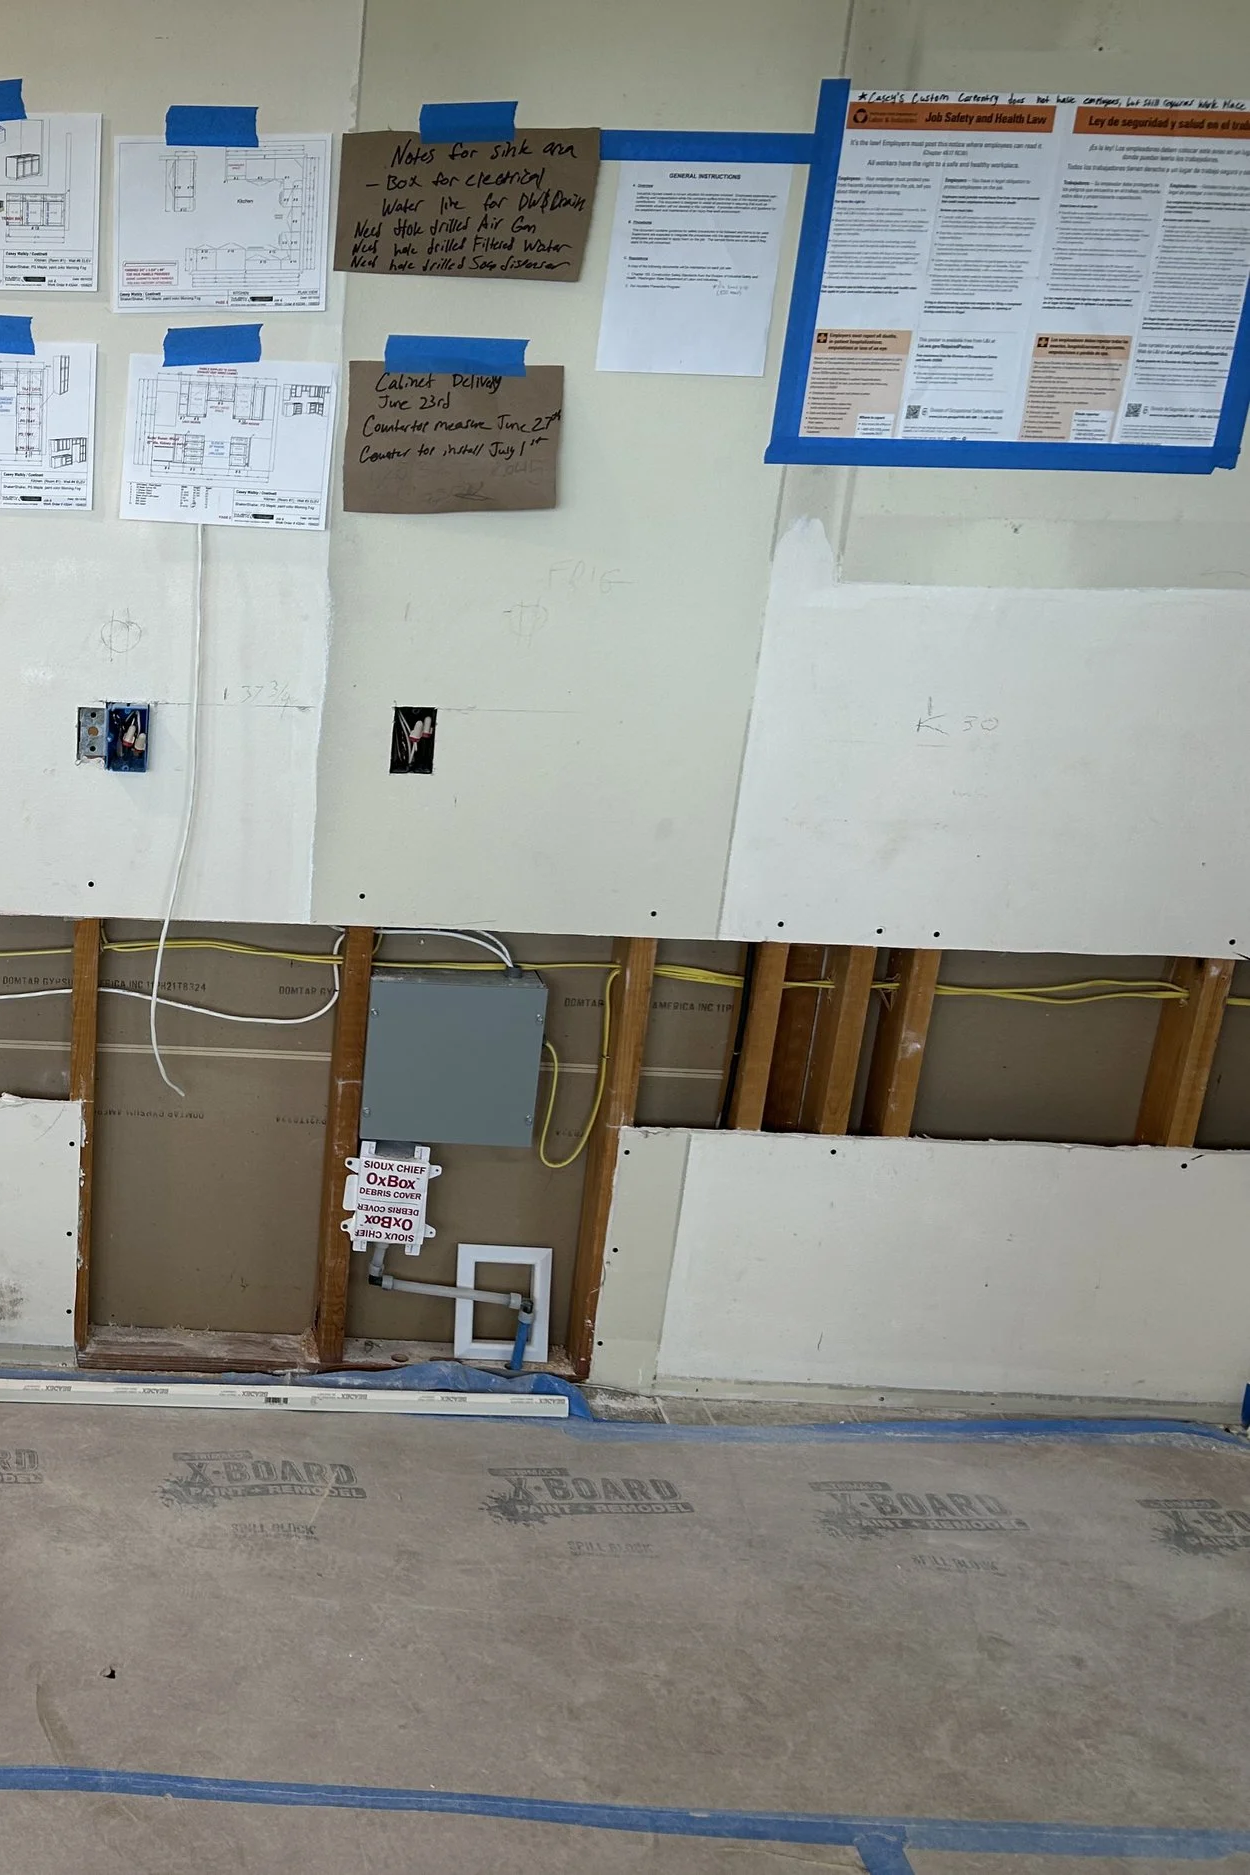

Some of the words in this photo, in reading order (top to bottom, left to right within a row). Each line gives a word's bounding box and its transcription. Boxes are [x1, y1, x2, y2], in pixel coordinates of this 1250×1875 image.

[912, 92, 949, 103] Custom
[925, 112, 943, 123] Job
[944, 112, 975, 126] Safety
[976, 113, 993, 124] and
[994, 112, 1024, 125] Health
[1026, 114, 1046, 125] Law
[1088, 115, 1105, 129] Ley
[1107, 116, 1119, 127] de
[1121, 116, 1168, 130] seguridad
[1170, 119, 1177, 130] y
[1178, 118, 1205, 130] salud
[1207, 121, 1219, 130] en
[390, 139, 434, 168] Notes
[448, 142, 478, 159] for
[490, 140, 532, 159] sink
[543, 142, 578, 159] area
[387, 173, 421, 190] Box
[432, 171, 459, 188] for
[698, 173, 741, 181] INSTRUCTIONS
[382, 198, 425, 217] Water
[483, 192, 508, 212] for
[430, 216, 471, 236] drilled
[477, 213, 504, 233] Air
[427, 236, 467, 255] drilled
[472, 234, 515, 252] Filtered
[524, 239, 572, 253] Water
[422, 256, 466, 272] drilled
[378, 395, 411, 410] June
[420, 392, 450, 410] 23rd
[497, 414, 532, 433] June
[488, 442, 515, 461] July
[2, 976, 41, 986] DOMTAR
[278, 985, 318, 996] DOMTAR
[651, 1001, 695, 1012] AMERICA
[697, 1002, 713, 1013] INC
[363, 1160, 394, 1172] SIOUX
[396, 1164, 427, 1175] CHIEF
[366, 1172, 416, 1190] OxBox
[359, 1186, 391, 1198] DEBRIS
[393, 1191, 422, 1201] COVER
[357, 1203, 386, 1213] COVER
[387, 1206, 419, 1217] DEBRIS
[364, 1214, 413, 1231] OxBox
[354, 1229, 382, 1239] CHIEF
[384, 1233, 415, 1243] SIOUX
[190, 1487, 245, 1497] PAINT
[269, 1485, 365, 1498] REMODEL
[517, 1504, 571, 1514] PAINT
[596, 1502, 691, 1513] REMODEL
